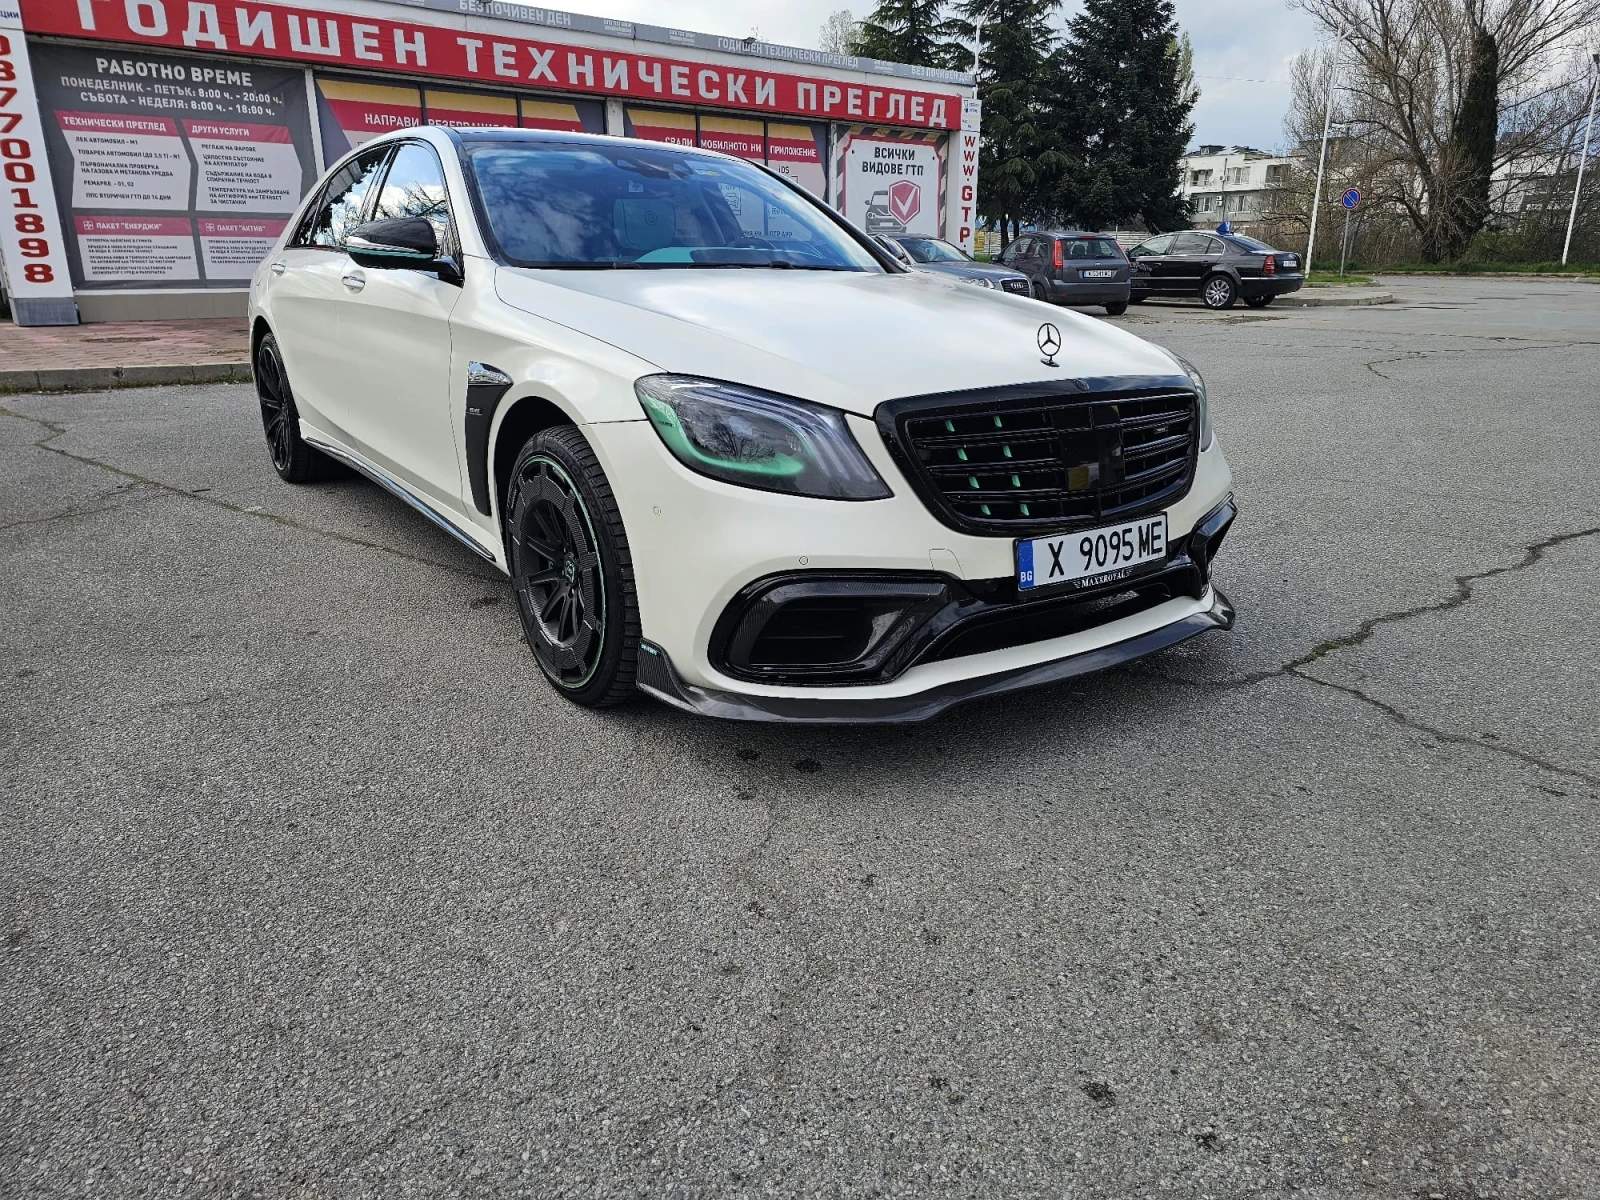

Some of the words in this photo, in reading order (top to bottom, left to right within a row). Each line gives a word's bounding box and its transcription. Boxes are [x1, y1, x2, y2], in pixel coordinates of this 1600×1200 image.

[486, 2, 544, 21] ПОЧИВЕН
[547, 11, 571, 26] ДЕН
[718, 37, 762, 53] ГОДИШЕН
[764, 44, 821, 62] ТЕХНИЧЕСКИ
[822, 53, 859, 68] ПРЕГЛЕД
[77, 0, 428, 67] ГОДИШЕН
[457, 37, 776, 107] ТЕХНИЧЕСКИ
[797, 82, 947, 128] ПРЕГЛЕД
[96, 57, 186, 80] РАБОТНО
[190, 66, 253, 87] ВРЕМЕ
[926, 66, 958, 80] ПОЧИВЕН
[61, 76, 144, 93] ПОНЕДЕЛНИК
[154, 84, 196, 97] ПЕТЪК:
[198, 88, 221, 99] 8:00
[243, 92, 271, 103] 20:00
[80, 92, 128, 105] СЪБОТА
[138, 96, 189, 109] НЕДЕЛЯ:
[191, 101, 214, 111] 8:00
[236, 104, 263, 115] 18:00
[63, 116, 124, 128] ТЕХНИЧЕСКИ
[126, 120, 167, 132] ПРЕГЛЕД
[365, 113, 419, 127] НАПРАВИ
[192, 125, 220, 134] ДРУГИ
[220, 127, 250, 136] УСЛУГИ
[700, 140, 747, 151] МОБИЛНОТО
[751, 143, 761, 152] НИ
[770, 145, 817, 157] ПРИЛОЖЕНИЕ
[874, 147, 915, 160] ВСИЧКИ
[862, 161, 903, 175] ВИДОВЕ
[905, 164, 924, 176] ГТП
[1048, 541, 1064, 578] X
[1020, 571, 1033, 582] BG
